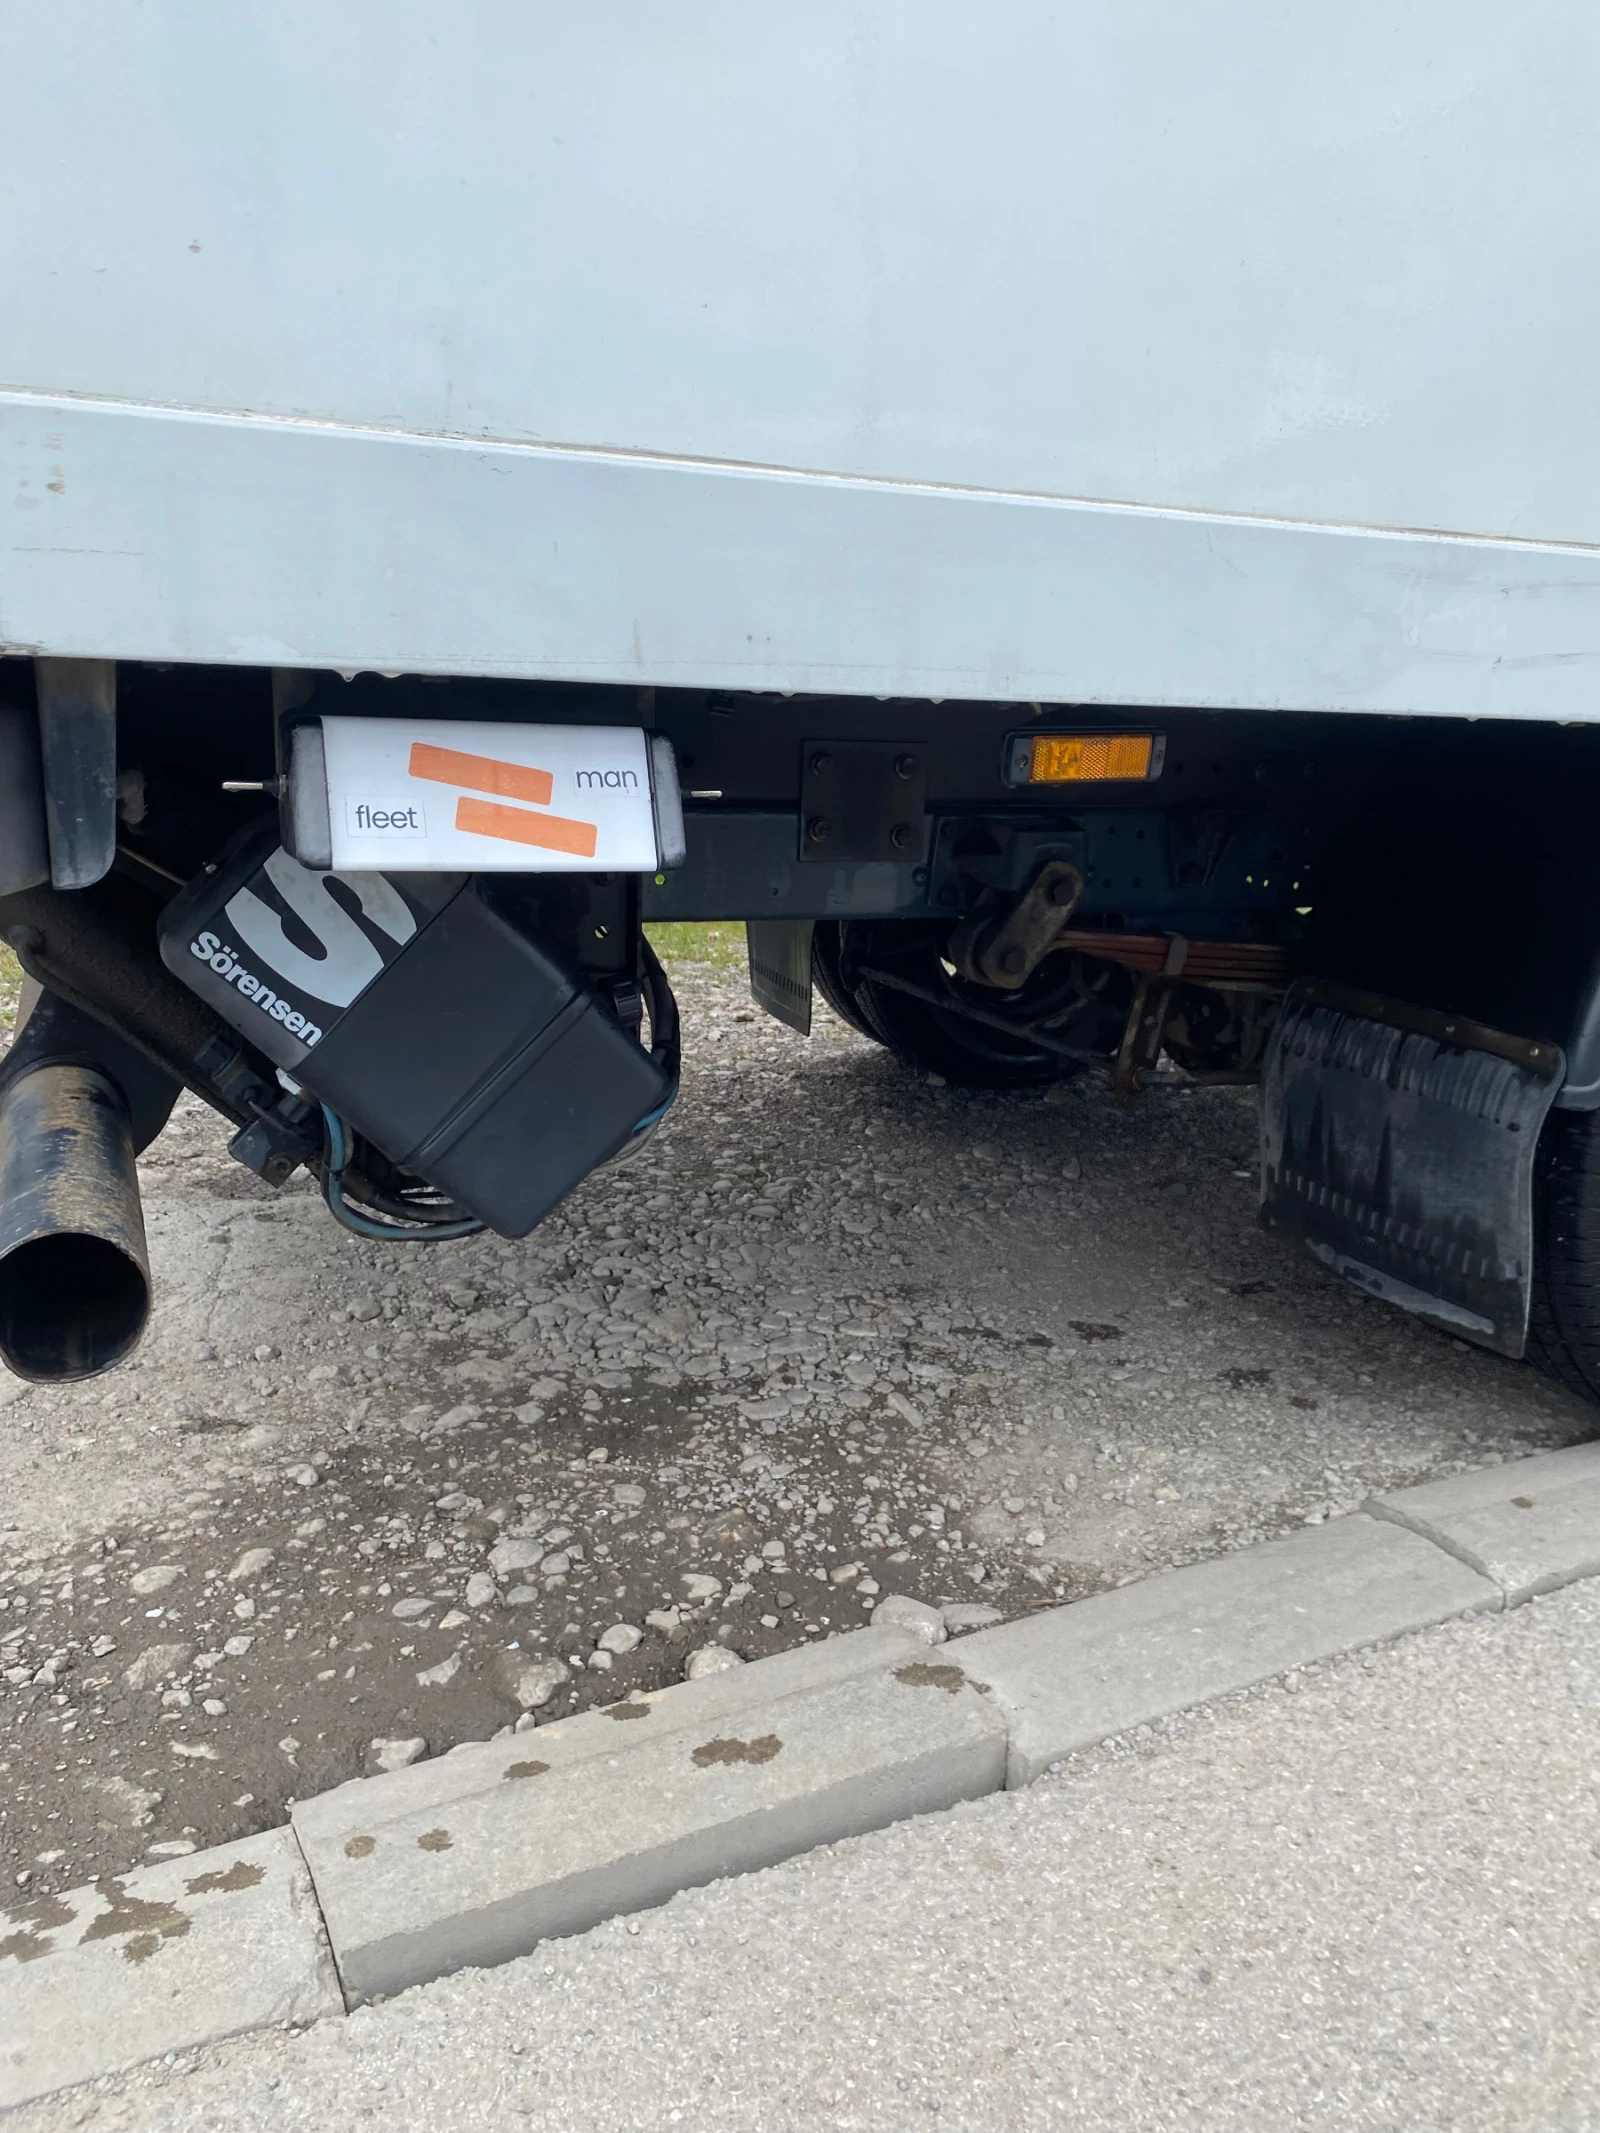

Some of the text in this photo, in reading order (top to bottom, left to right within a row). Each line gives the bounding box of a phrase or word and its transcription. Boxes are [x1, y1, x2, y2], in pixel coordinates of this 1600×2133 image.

[576, 768, 638, 789] man
[355, 804, 418, 829] fleet
[191, 930, 322, 1047] Sörensen
